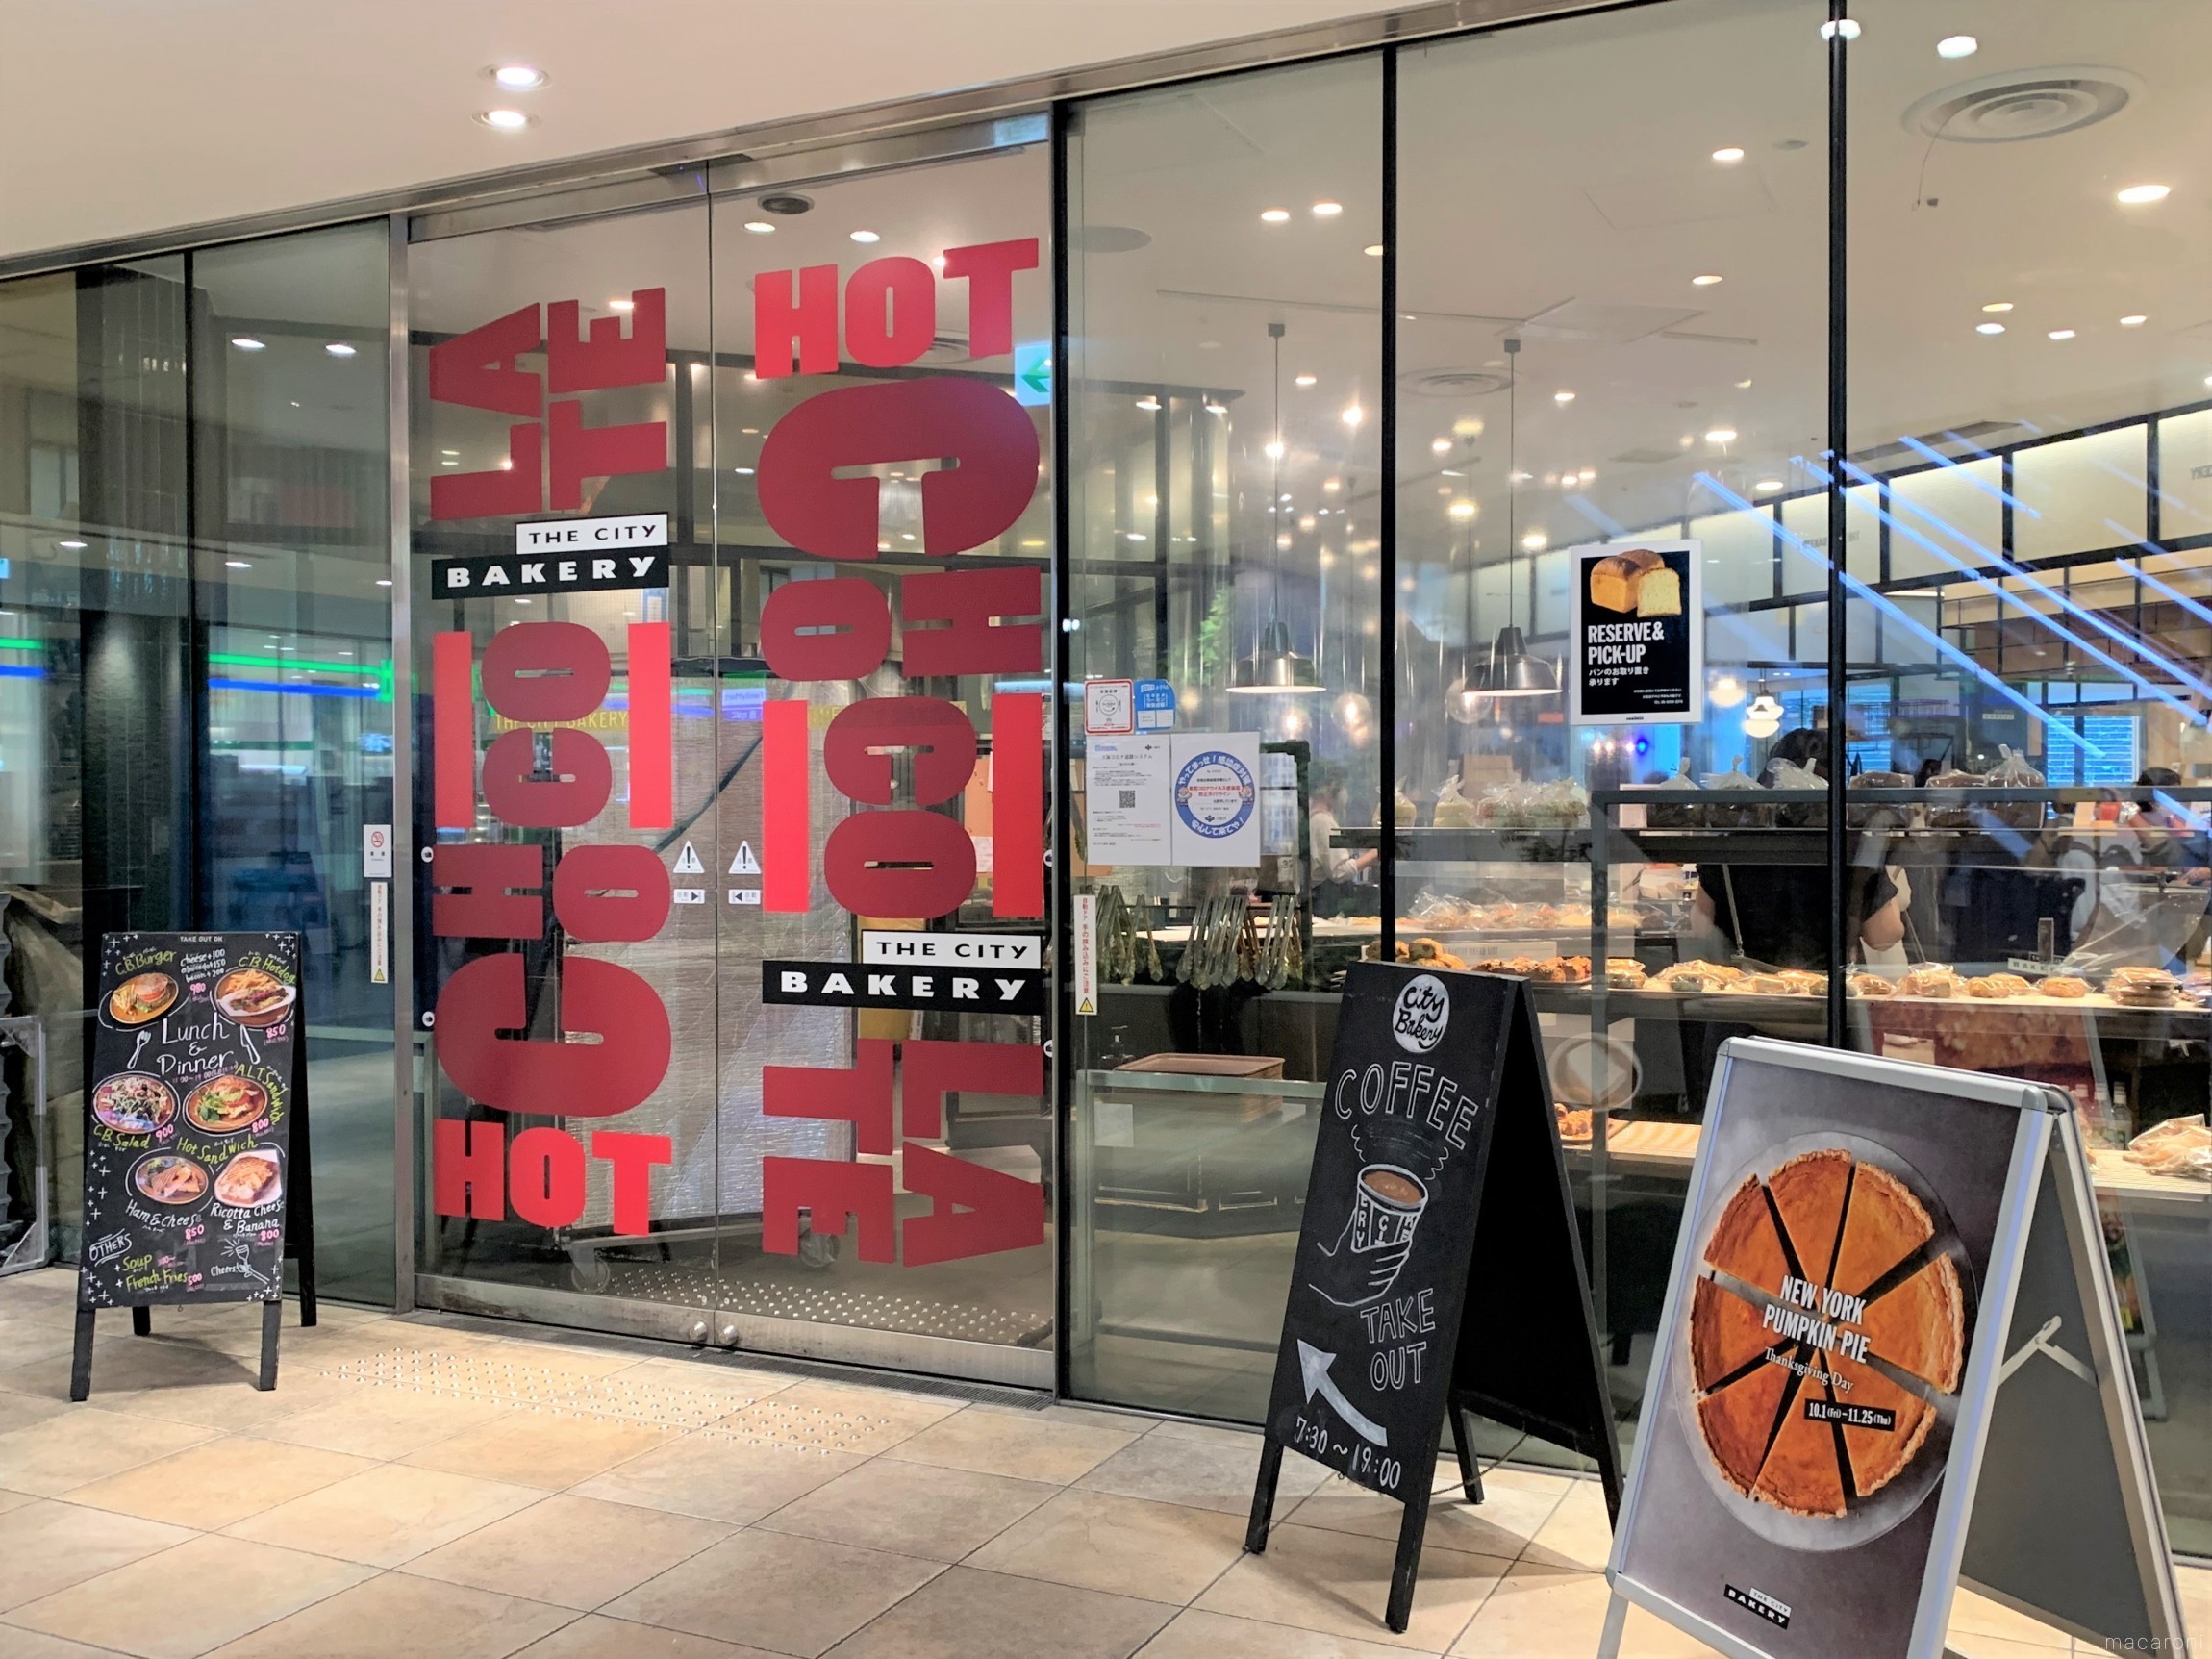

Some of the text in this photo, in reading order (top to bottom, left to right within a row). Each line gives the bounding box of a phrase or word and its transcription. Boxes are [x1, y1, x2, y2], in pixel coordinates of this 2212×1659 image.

[755, 238, 1039, 380] HOT
[528, 524, 657, 544] THE CITY
[447, 556, 656, 588] BAKERY
[1588, 644, 1646, 665] PICK-UP
[876, 942, 1028, 959] THE CITY
[262, 957, 296, 984] Hotdog
[780, 971, 1026, 1001] BAKERY
[1403, 986, 1445, 1023] City
[162, 1012, 230, 1045] Lunch
[265, 1023, 286, 1039] 850
[1395, 1008, 1443, 1050] Bakery
[156, 1050, 234, 1075] Dinner
[188, 1042, 207, 1056] &
[1334, 1060, 1479, 1150] COFFEE
[113, 1133, 152, 1149] Salad
[155, 1123, 174, 1144] 900
[251, 1118, 269, 1134] 800
[176, 1133, 259, 1165] Hot Sandwich
[433, 1119, 672, 1238] HOT
[210, 1199, 285, 1219] Ricotta Cheese
[184, 1224, 205, 1240] 850
[235, 1218, 281, 1235] Banana
[122, 1254, 153, 1271] Soup
[125, 1269, 203, 1293] French Fries 500
[1779, 1274, 1866, 1325] NEW YORK
[1360, 1288, 1436, 1344] TAKE
[1762, 1303, 1872, 1364] PUMPKIN PIE
[1370, 1341, 1427, 1391] OUT
[1765, 1346, 1854, 1394] Thanksgiving Day
[1294, 1416, 1328, 1454] 7:30
[1728, 1589, 1786, 1624] BAKERY
